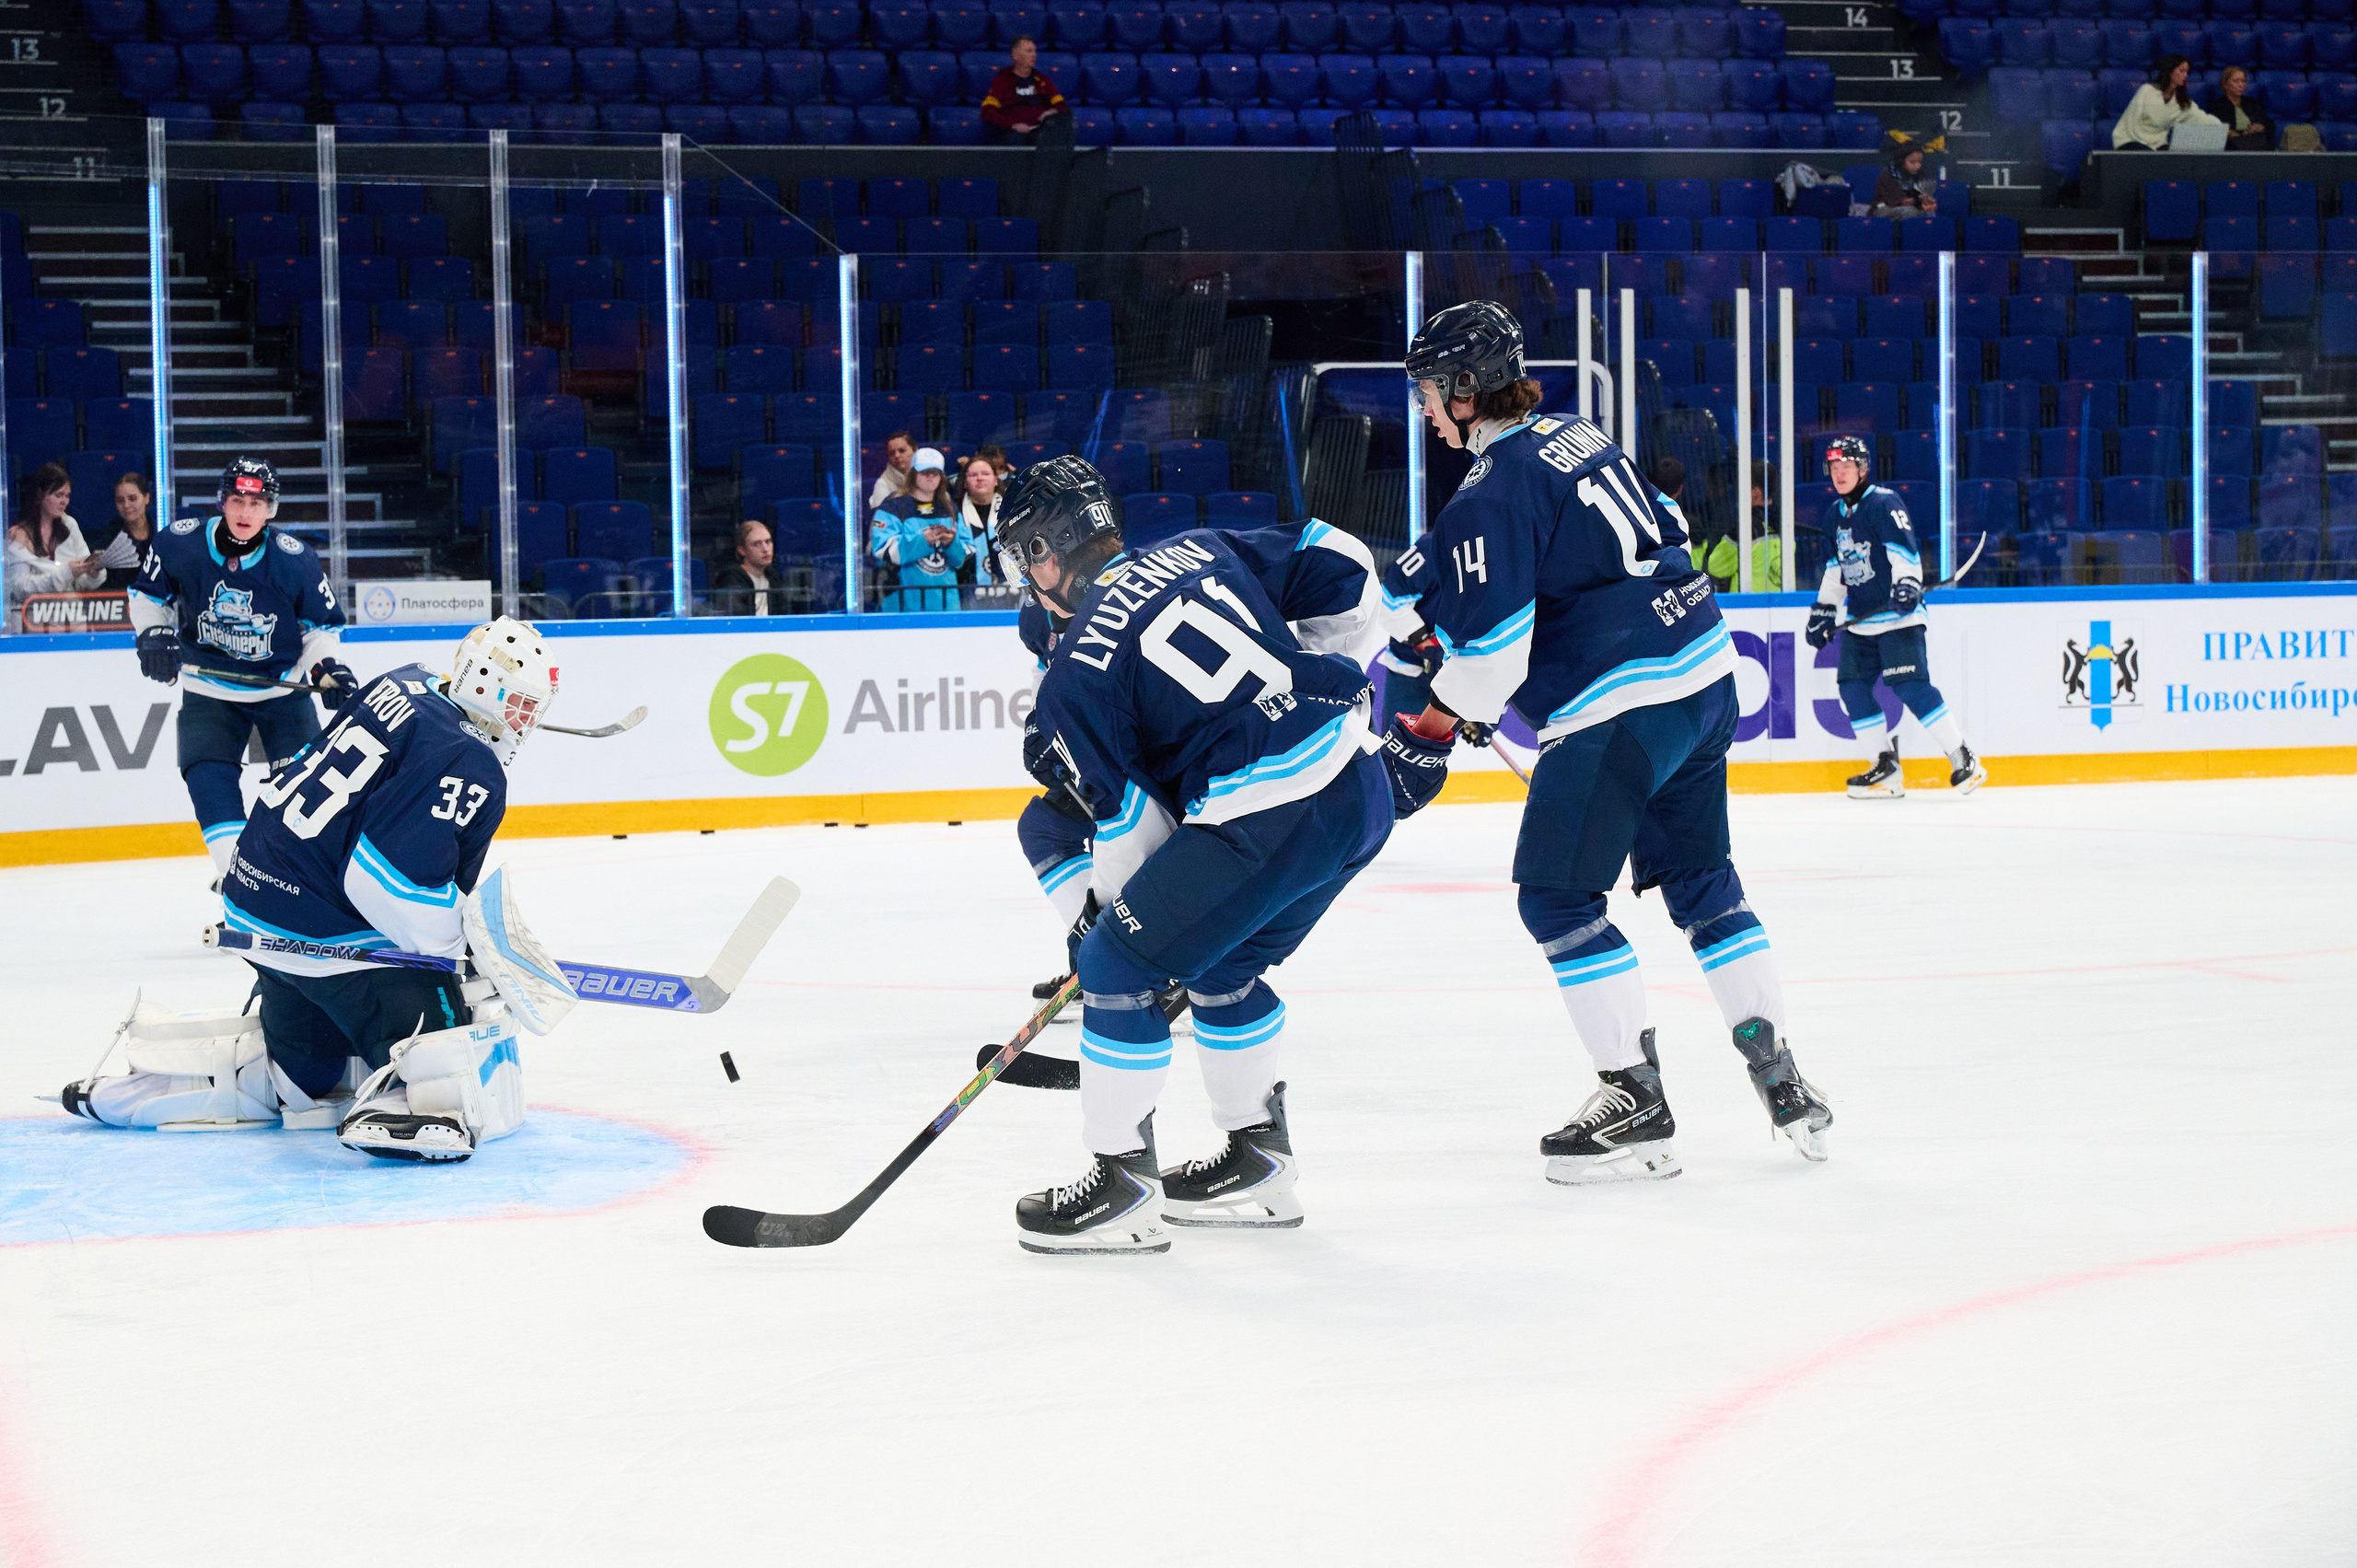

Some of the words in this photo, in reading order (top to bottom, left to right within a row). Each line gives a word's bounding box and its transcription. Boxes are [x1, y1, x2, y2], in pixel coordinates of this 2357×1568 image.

[1845, 7, 1868, 28] 14
[11, 38, 40, 62] 13
[1890, 59, 1914, 79] 13
[39, 97, 67, 120] 12
[1939, 110, 1963, 131] 12
[73, 157, 96, 180] 11
[1991, 168, 2011, 187] 11
[1090, 504, 1111, 528] 91
[1890, 509, 1912, 531] 12
[143, 546, 161, 582] 37
[1396, 545, 1425, 577] 10
[1452, 535, 1487, 594] 14
[32, 599, 124, 623] WINLINE
[401, 598, 484, 611] Платосфера
[1069, 538, 1216, 671] LYUZENKOV
[1139, 575, 1294, 704] 91
[2203, 629, 2354, 661] ПРАВИТ
[454, 658, 473, 693] BAUER
[2165, 680, 2357, 717] Новосибир
[725, 680, 810, 752] S7
[0, 702, 172, 777] AV
[1382, 729, 1448, 768] BAUER
[431, 775, 490, 828] 33
[259, 937, 360, 959] SHADOW
[562, 970, 679, 1003] BAUER
[1632, 1104, 1663, 1129] BAUER
[1207, 1174, 1240, 1193] BAUER
[1074, 1202, 1110, 1225] BAUER
